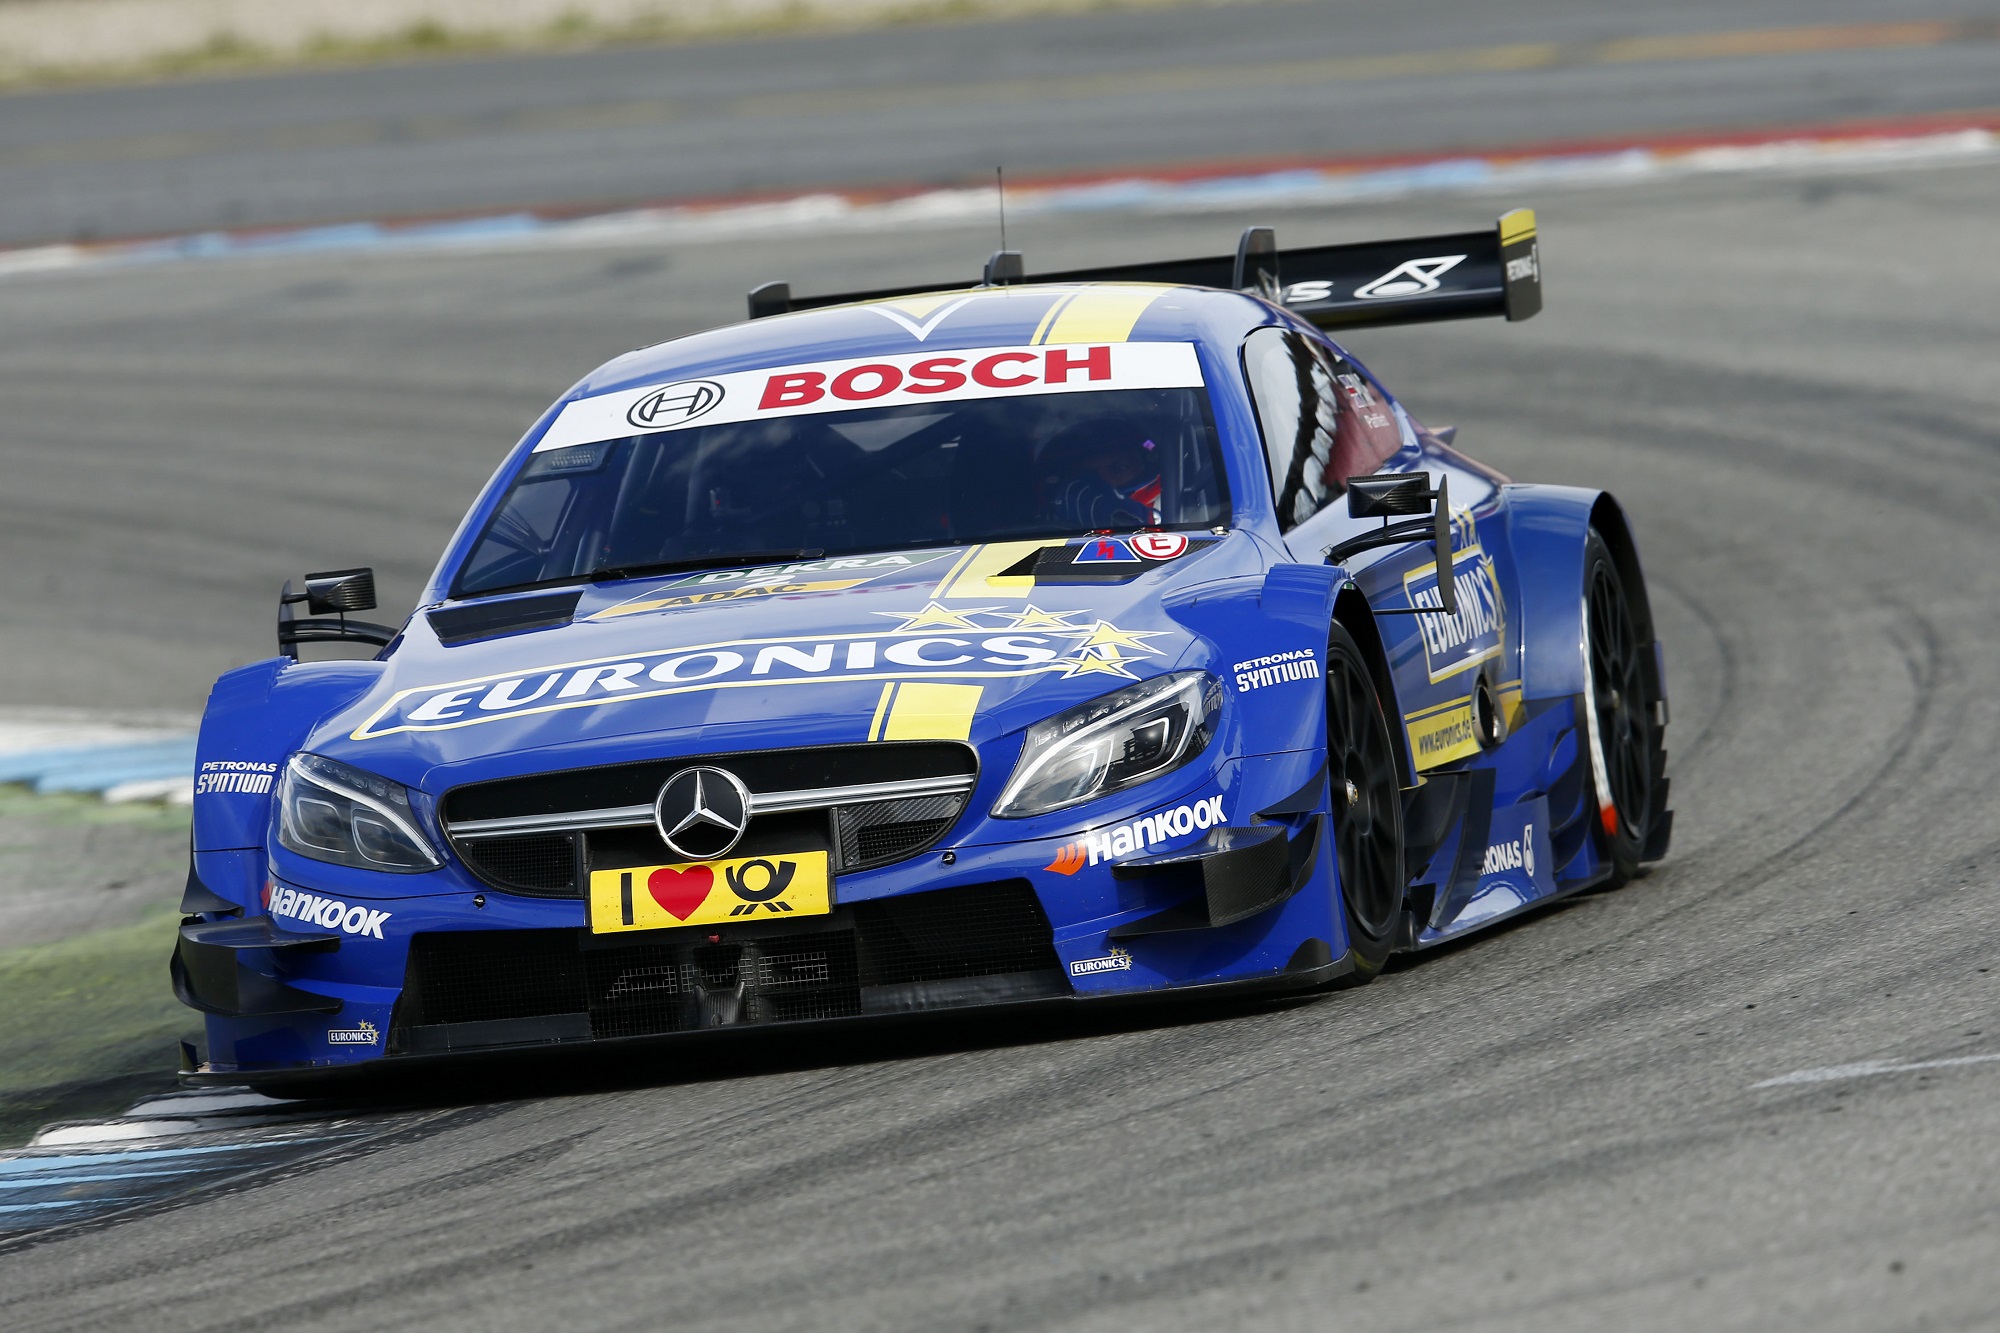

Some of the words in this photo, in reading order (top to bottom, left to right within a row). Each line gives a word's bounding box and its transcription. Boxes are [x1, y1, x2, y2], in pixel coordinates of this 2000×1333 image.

[757, 346, 1111, 410] BOSCH
[698, 555, 913, 583] DEKRA
[655, 583, 808, 609] ADAC
[1233, 648, 1315, 673] PETRONAS
[406, 634, 1060, 721] EURONICS
[1236, 659, 1320, 693] SYNTIUM
[1418, 714, 1472, 756] www.euronics.de
[201, 761, 277, 773] PETRONAS
[196, 772, 273, 795] SYNTIUM
[620, 872, 634, 926] I
[1073, 957, 1126, 974] EURONICS
[330, 1030, 374, 1043] EURONICS
